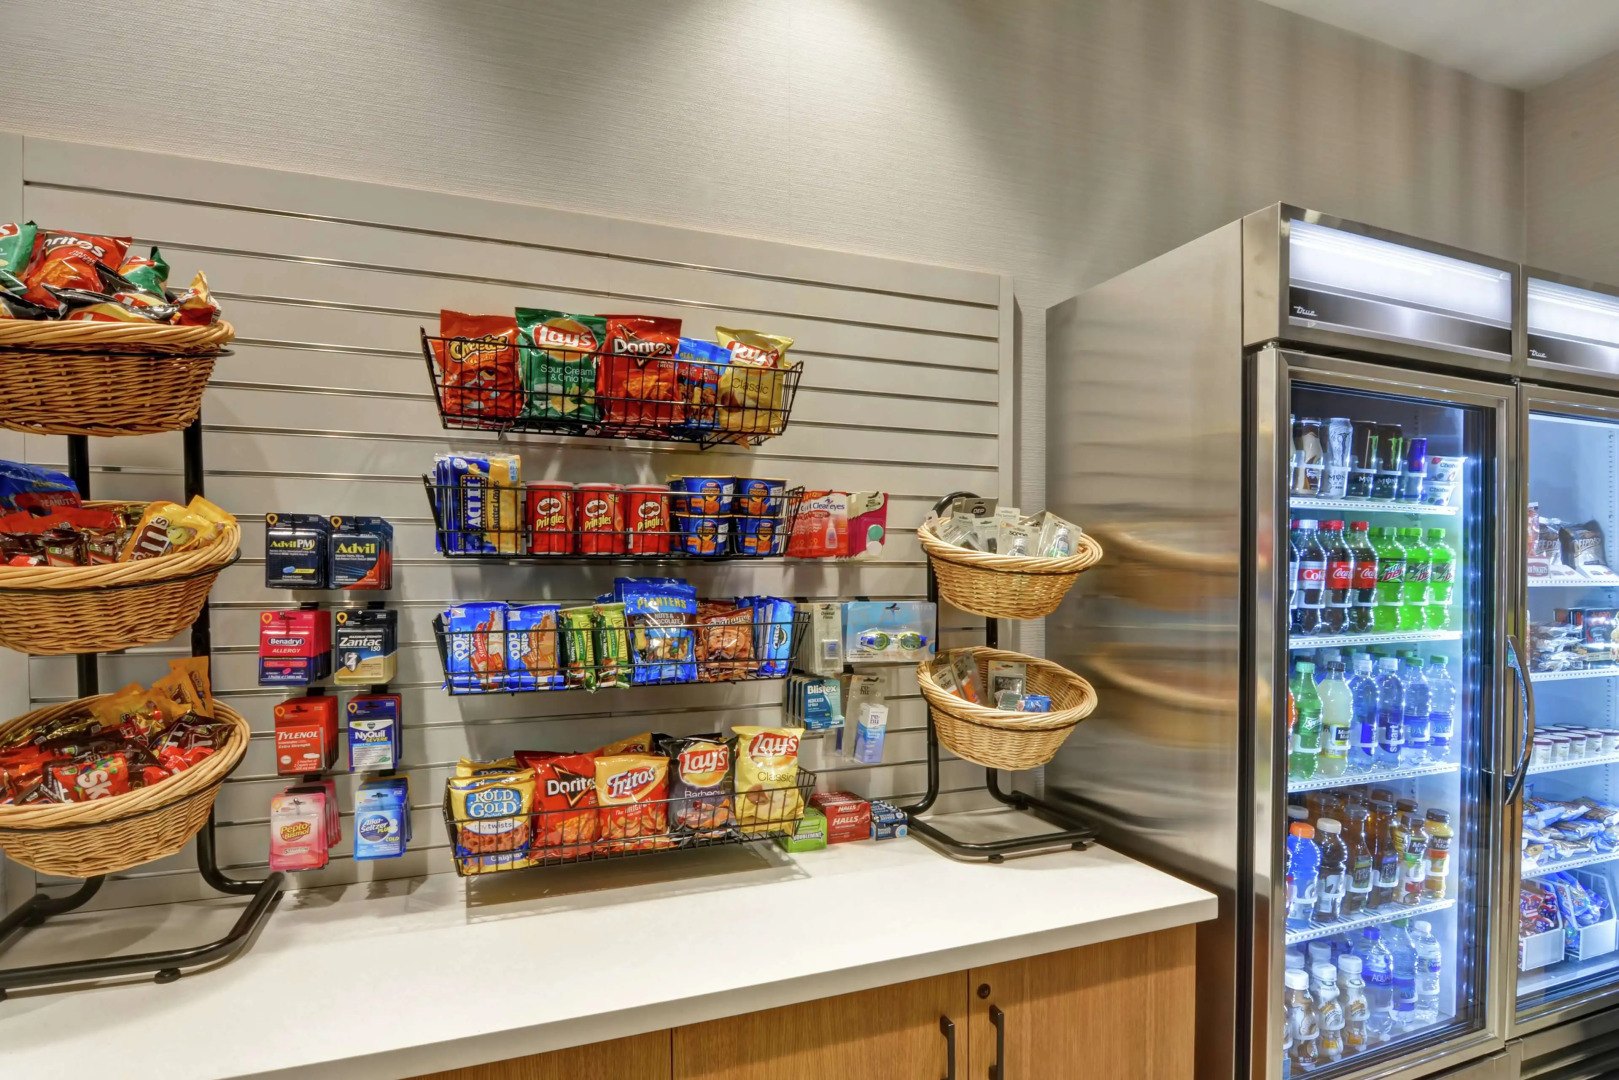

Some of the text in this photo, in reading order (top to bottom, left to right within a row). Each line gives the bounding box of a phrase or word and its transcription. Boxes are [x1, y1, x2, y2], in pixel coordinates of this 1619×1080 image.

[43, 235, 106, 258] oritos
[539, 326, 592, 348] Lay's
[613, 338, 673, 356] Doritos
[812, 502, 846, 512] Clear eyes
[536, 513, 565, 531] Pringles
[584, 514, 612, 531] Pringles
[270, 539, 314, 549] Advil PM
[336, 542, 376, 554] Advil
[637, 596, 687, 610] PLANTERS
[270, 638, 303, 646] Benadryl
[339, 637, 383, 647] Zantac
[807, 685, 837, 696] Blistex
[277, 731, 318, 741] TYLENOL
[355, 730, 386, 741] NyQuil
[750, 734, 798, 758] Lay's
[683, 749, 727, 774] Lay's
[606, 768, 655, 798] Fritos
[757, 771, 794, 782] Classic
[475, 789, 514, 803] ROLD
[470, 801, 518, 818] GOLD
[361, 821, 389, 833] Seltzer
[832, 816, 859, 826] HALLS
